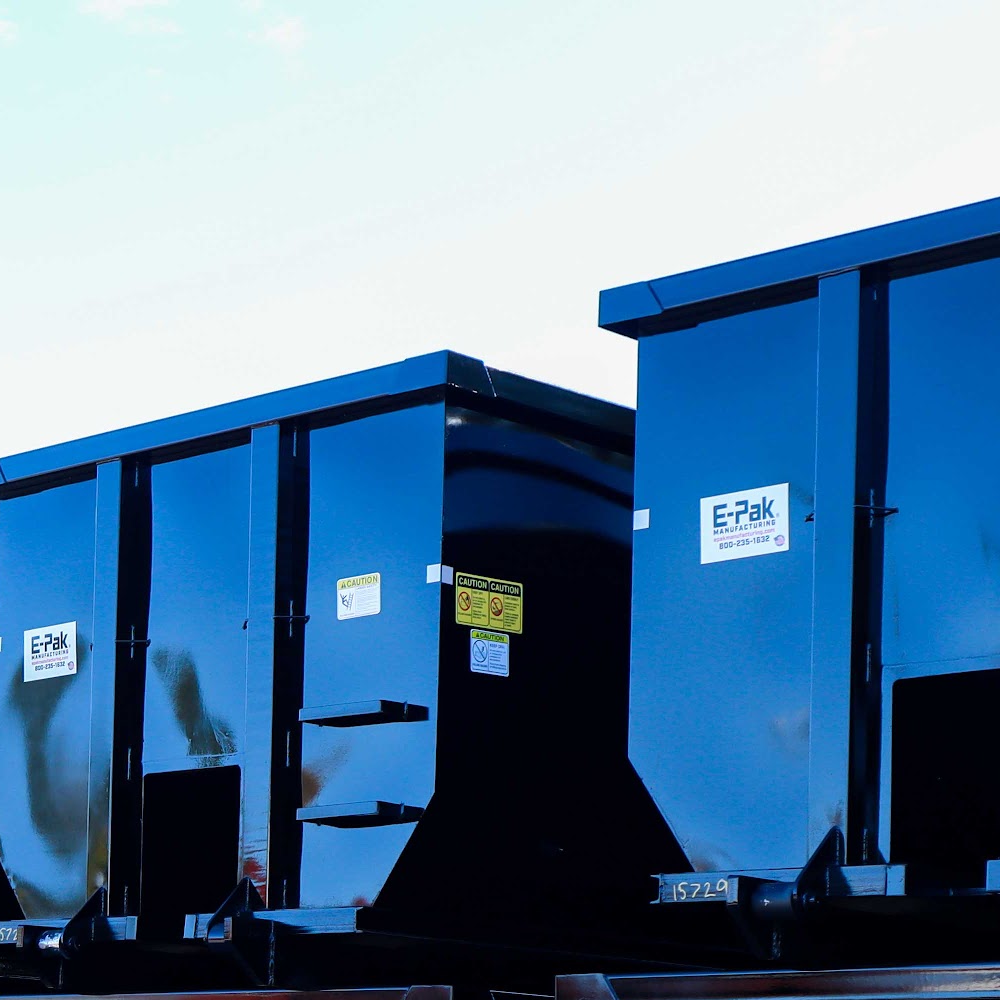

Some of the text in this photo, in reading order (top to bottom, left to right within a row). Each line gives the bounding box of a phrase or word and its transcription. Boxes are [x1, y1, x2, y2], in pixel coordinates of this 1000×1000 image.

[713, 496, 775, 528] E-Pak
[713, 520, 776, 535] MANUFACTURING
[719, 535, 770, 549] 800-235-1632
[347, 575, 378, 587] CAUTION
[458, 577, 519, 595] CAUTION CAUTION
[31, 631, 68, 654] E-Pak
[480, 632, 505, 641] CAUTION
[673, 878, 728, 901] 15729
